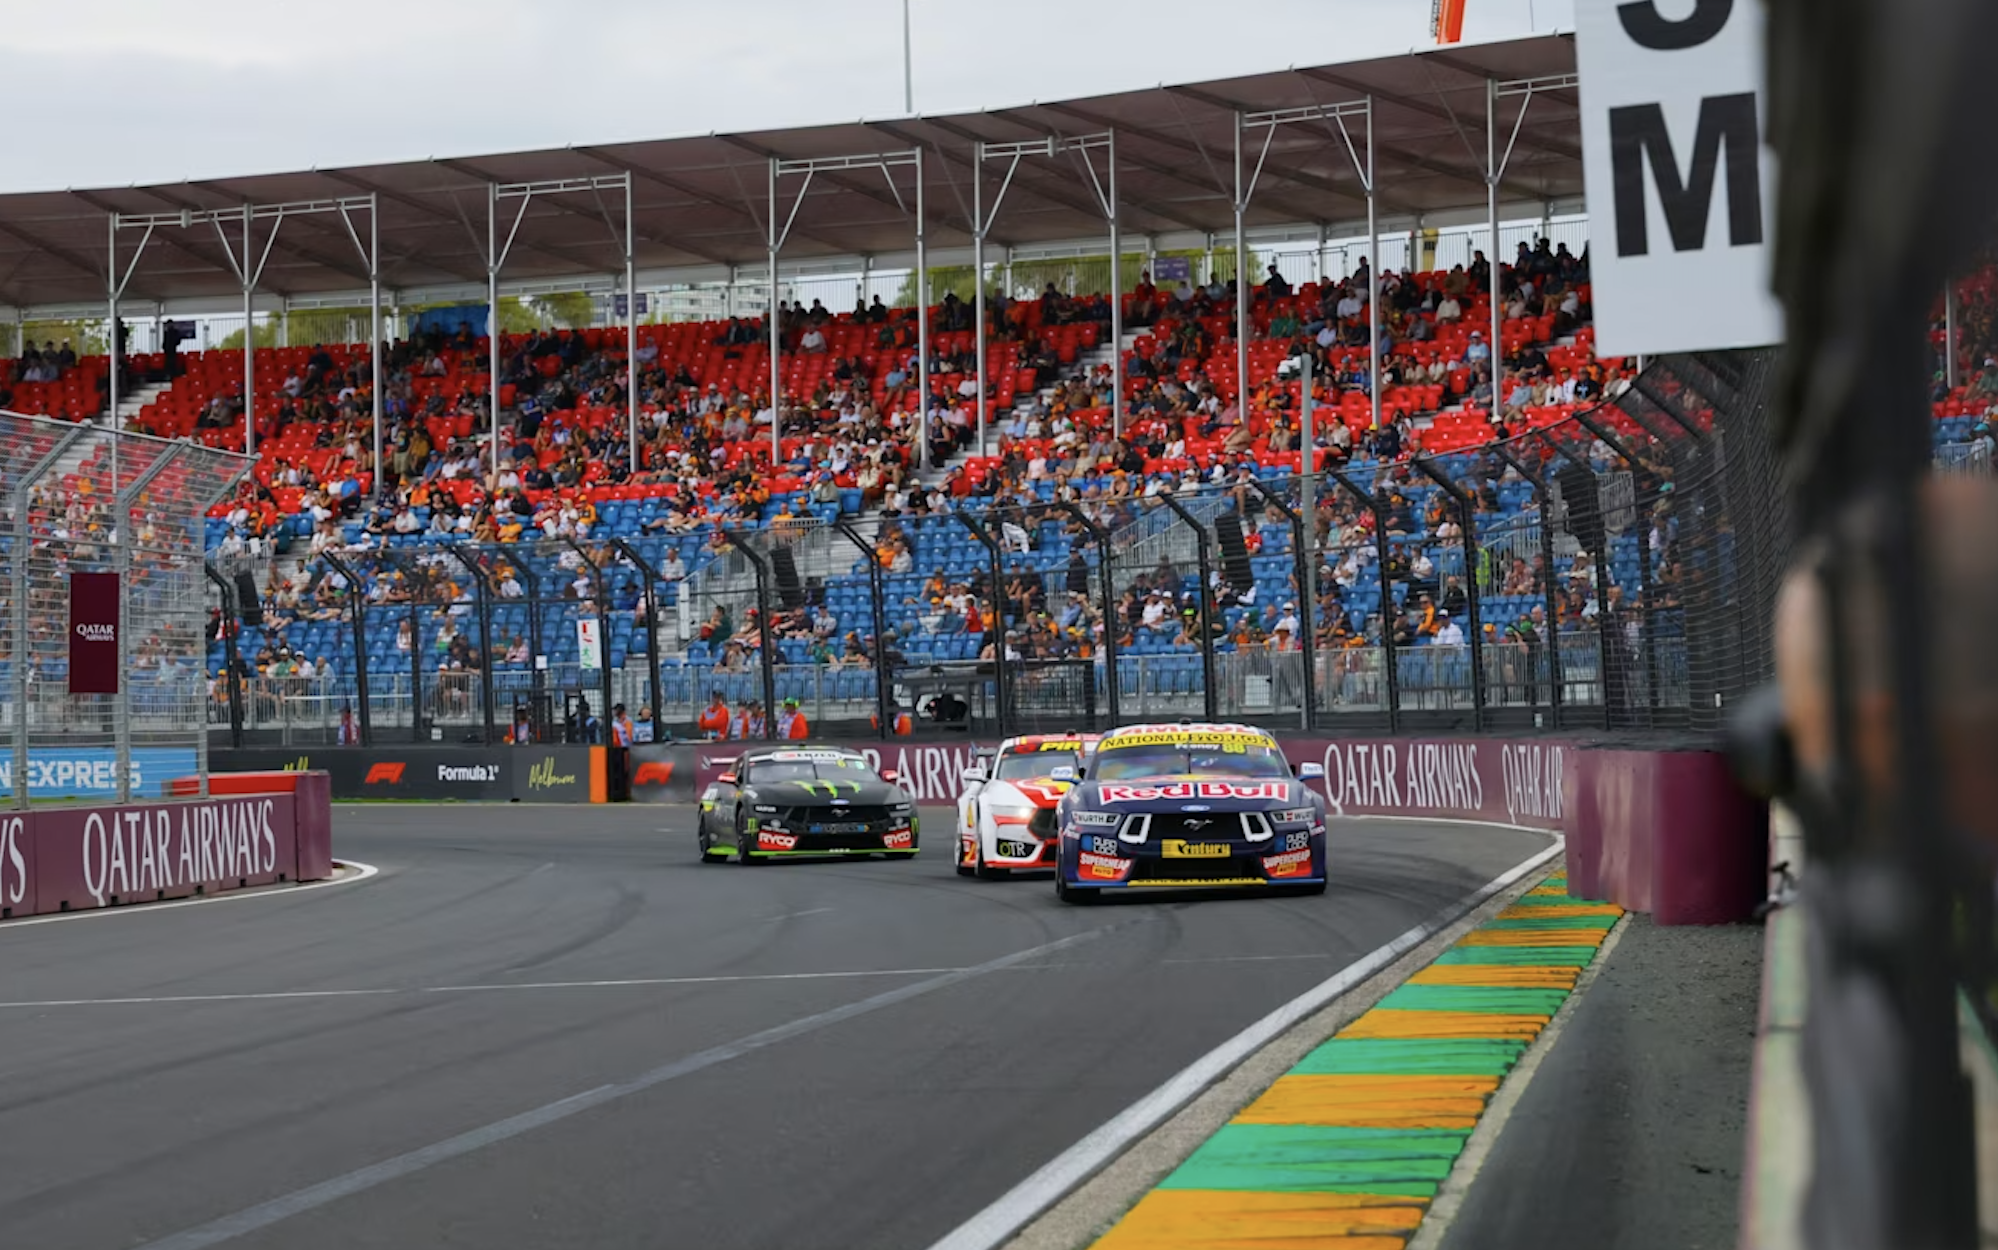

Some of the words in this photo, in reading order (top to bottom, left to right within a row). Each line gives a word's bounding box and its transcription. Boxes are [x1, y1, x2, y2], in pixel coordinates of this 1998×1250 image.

[76, 622, 115, 637] QATAR
[85, 633, 115, 642] AIRWAYS
[1104, 733, 1187, 748] NATIONAL
[437, 764, 487, 781] Formula
[528, 755, 576, 791] Melbourne
[1324, 742, 1401, 815] QATAR
[1406, 742, 1482, 811] AIRWAYS
[1100, 783, 1193, 804] Red
[1199, 782, 1288, 802] Bull
[1501, 743, 1542, 825] QATAR
[759, 832, 797, 847] RYCO
[883, 830, 911, 848] RYCO
[83, 810, 173, 906] QATAR
[178, 798, 277, 885] AIRWAYS
[1000, 841, 1026, 858] OTR
[1262, 848, 1312, 870] SUPERCHEAP
[1079, 852, 1132, 872] SUPERCHEAP
